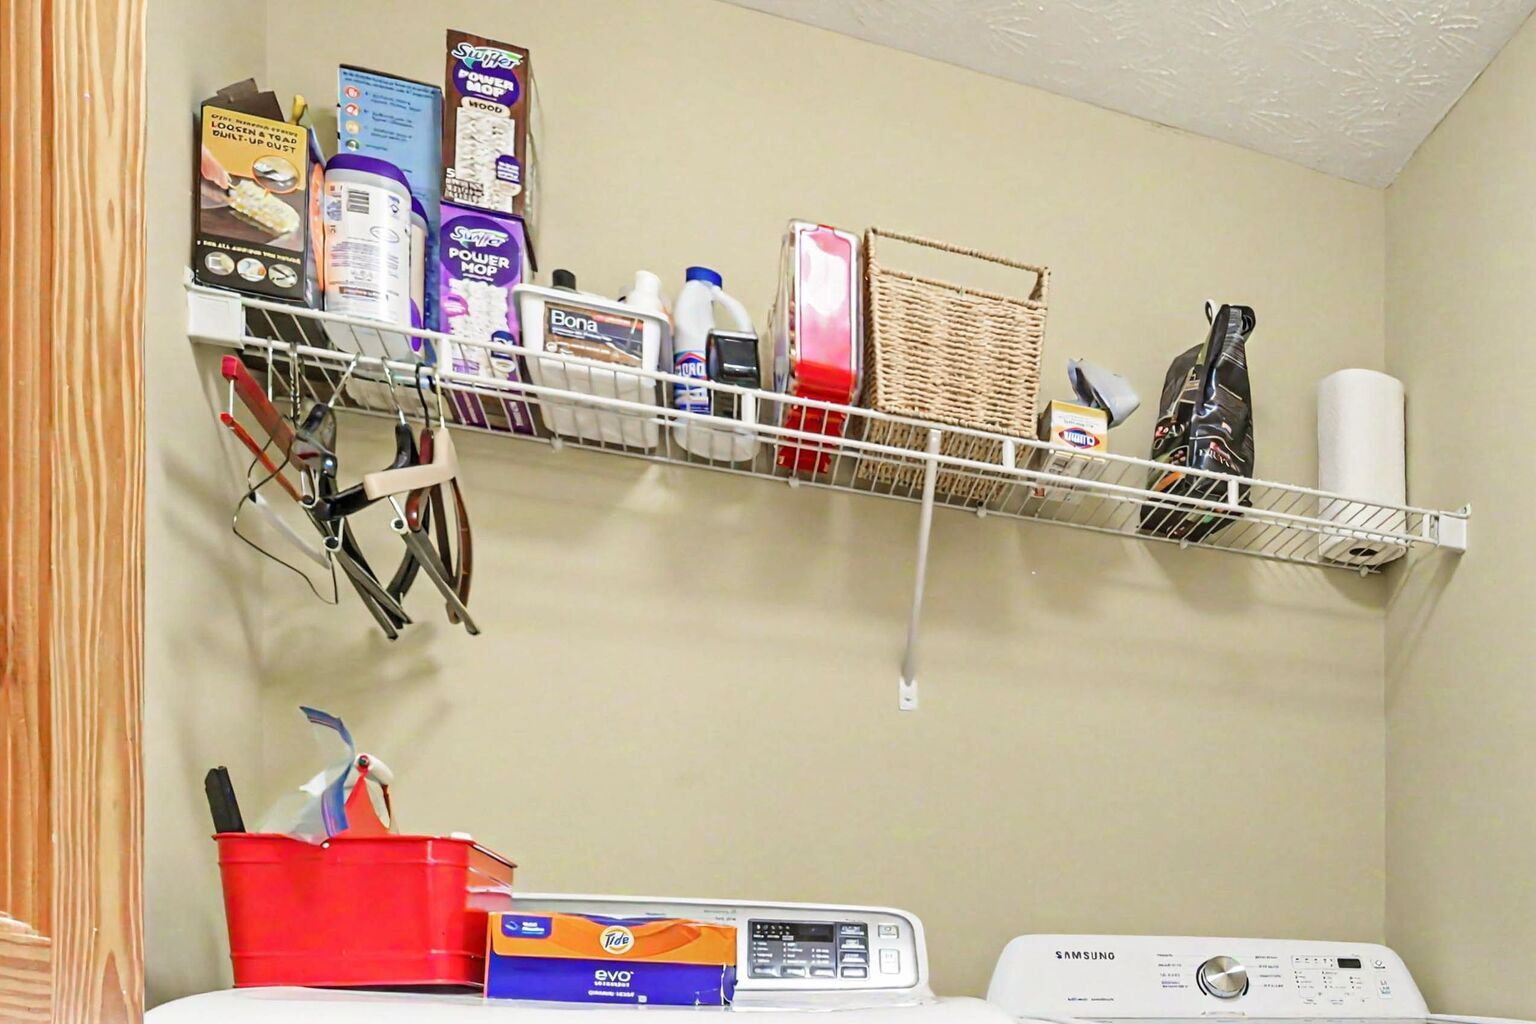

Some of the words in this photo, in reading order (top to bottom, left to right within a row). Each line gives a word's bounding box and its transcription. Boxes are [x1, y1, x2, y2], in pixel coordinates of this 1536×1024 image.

[458, 68, 514, 91] POWER
[466, 80, 508, 97] MOP
[469, 100, 502, 113] WOOD
[211, 121, 256, 136] LOOSEN
[266, 140, 296, 153] DUST
[448, 247, 510, 269] POWER
[461, 261, 498, 276] MOP
[551, 309, 598, 333] Bona
[605, 932, 629, 948] Tide
[1055, 950, 1115, 960] SAMSUNG
[595, 969, 632, 982] evo
